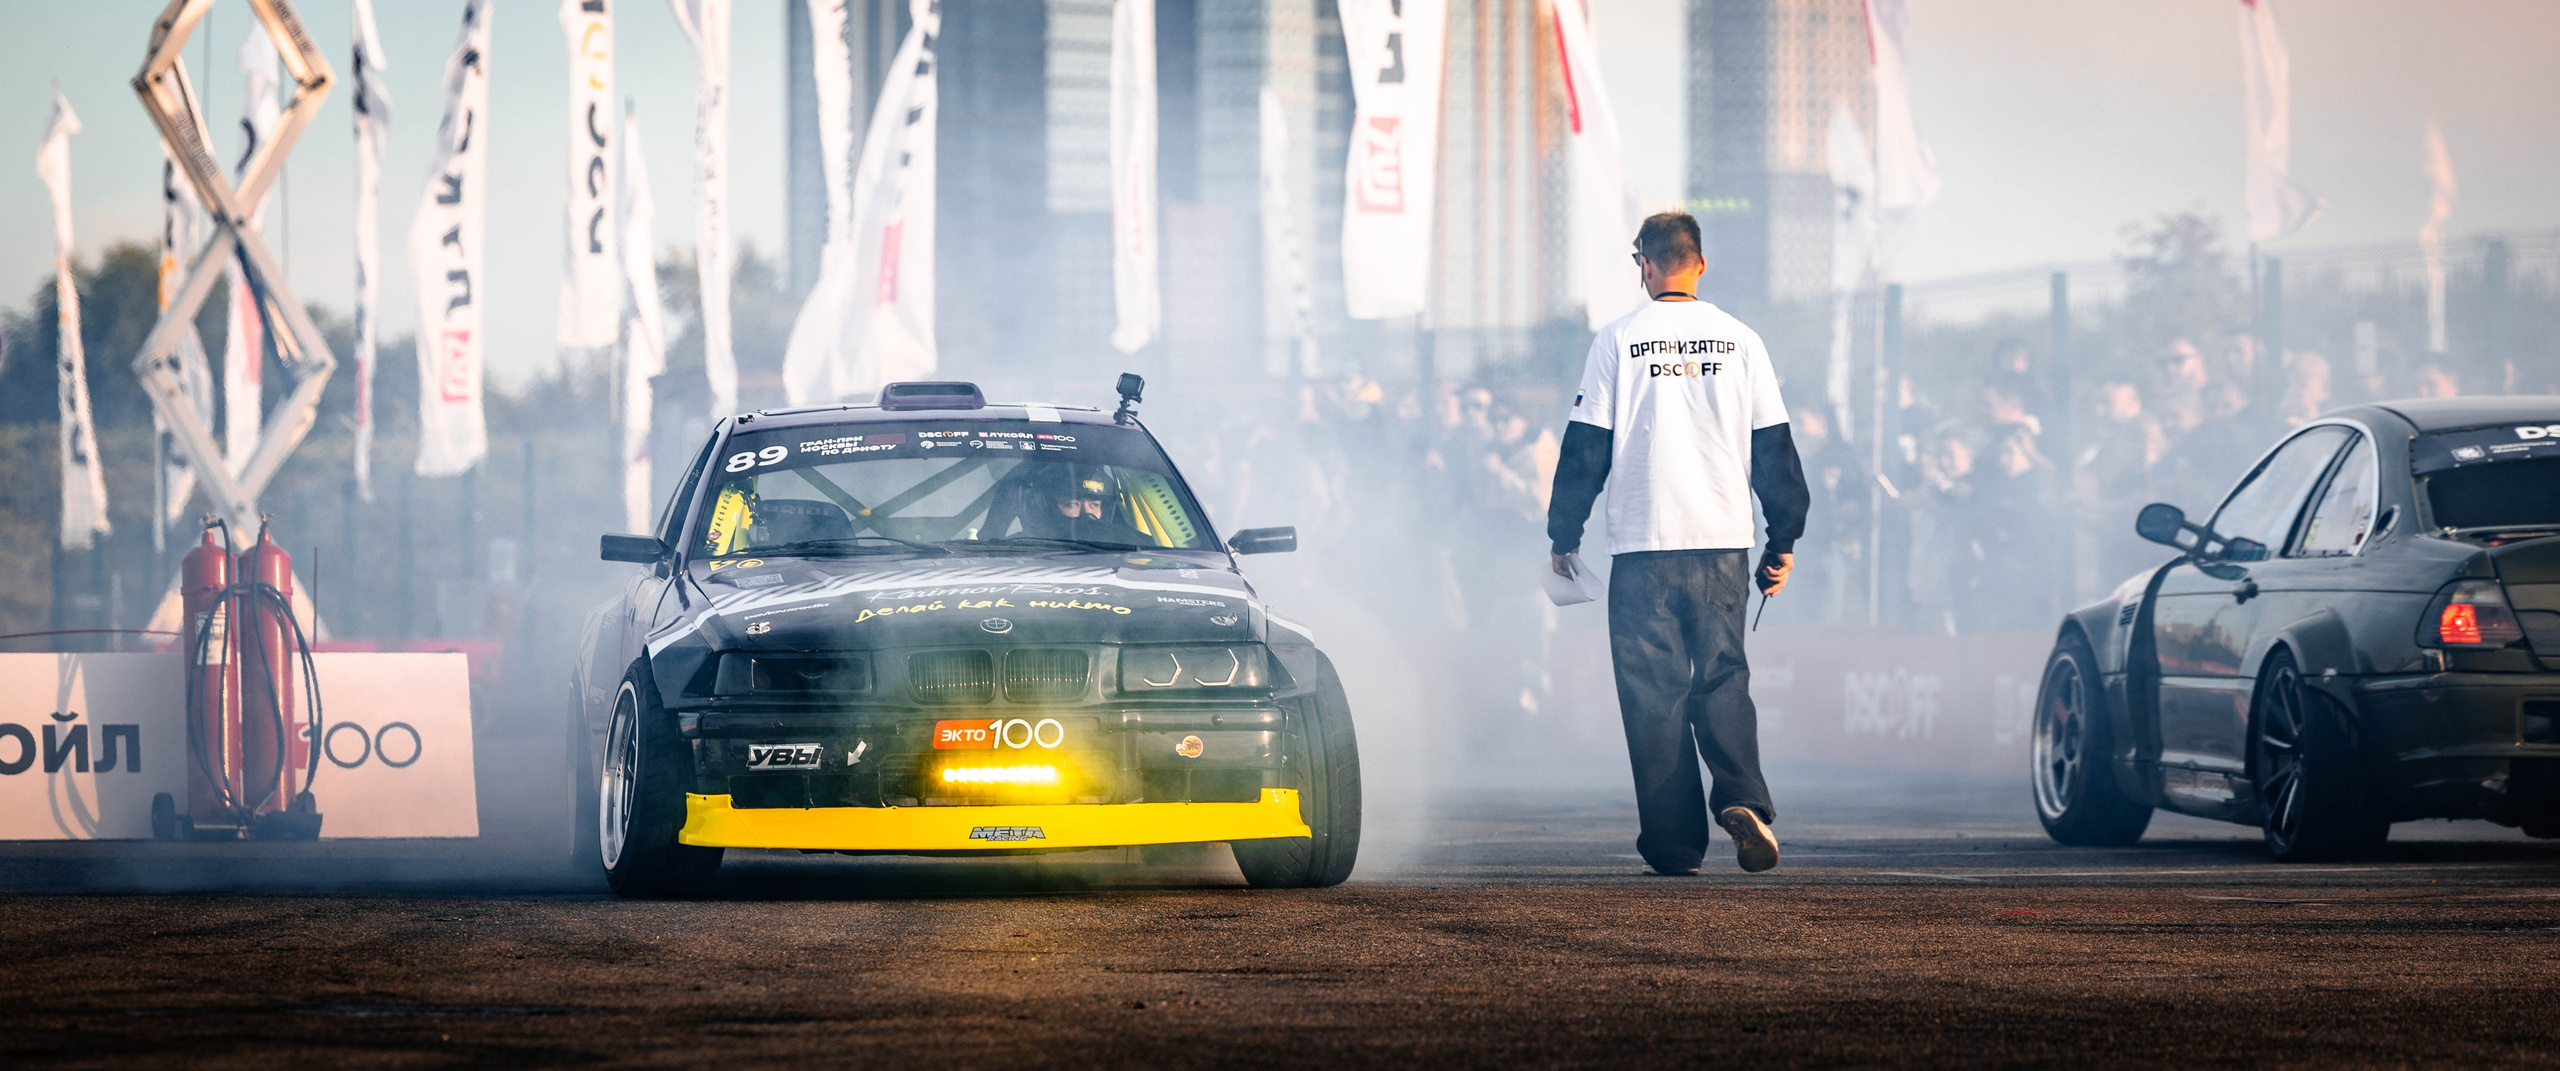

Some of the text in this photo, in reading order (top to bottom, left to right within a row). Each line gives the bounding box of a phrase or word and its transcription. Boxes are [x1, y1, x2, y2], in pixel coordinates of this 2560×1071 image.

[1630, 340, 1735, 358] ОРГАНИЗАТОР
[800, 436, 863, 447] ГРАН-ПРИ
[989, 431, 1034, 439] ЛУКОЙЛ
[801, 442, 857, 453] МОСКВЫ
[842, 444, 897, 455] ДРИФТУ
[725, 446, 788, 473] 89
[763, 504, 837, 518] BRIDE
[1157, 596, 1226, 607] HAMSTERS
[855, 600, 945, 623] Делай
[958, 598, 1015, 609] как
[940, 718, 1064, 749] ЭКТО 100
[749, 747, 823, 767] УВЫ
[969, 826, 1046, 839] META
[986, 834, 1029, 842] RACING
